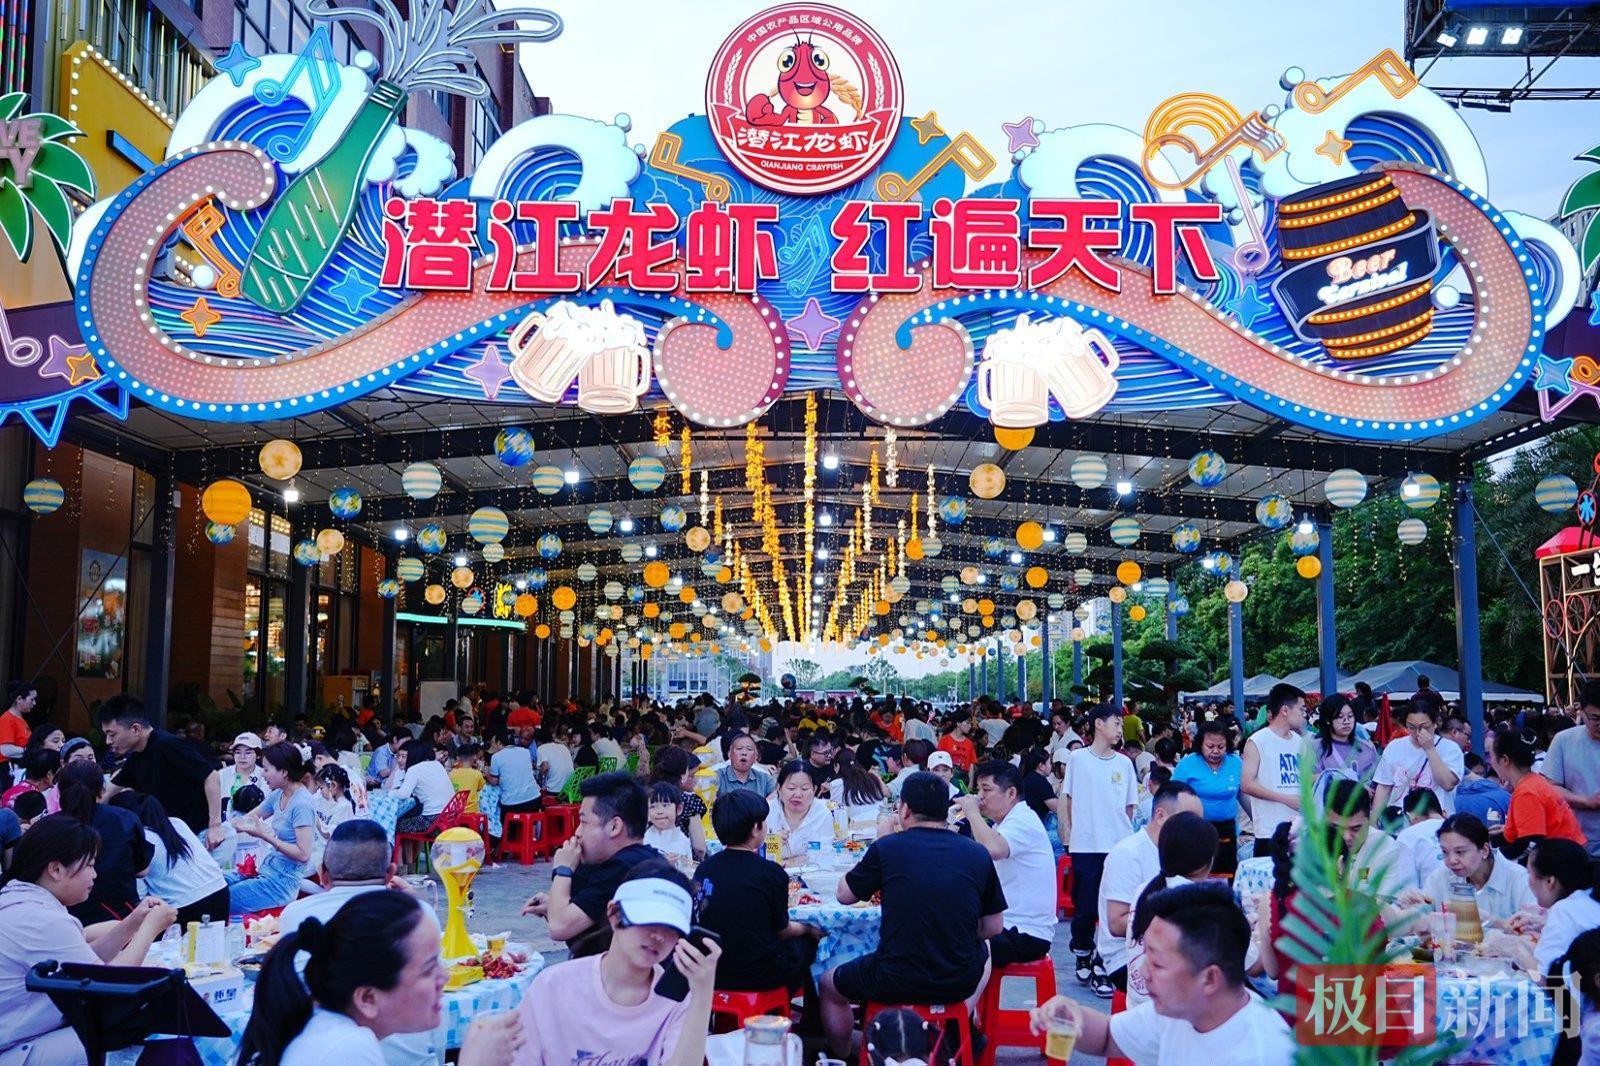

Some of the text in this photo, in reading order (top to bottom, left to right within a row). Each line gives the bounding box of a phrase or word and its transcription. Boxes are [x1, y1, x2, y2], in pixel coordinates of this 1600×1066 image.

[747, 14, 864, 46] 中国农产品区域公用品牌
[737, 126, 869, 153] 潜江龙虾
[760, 160, 844, 171] QIANJIANG CRAYFISH
[379, 197, 1223, 295] 潜江龙虾 红遍天下
[1326, 248, 1396, 284] Beer
